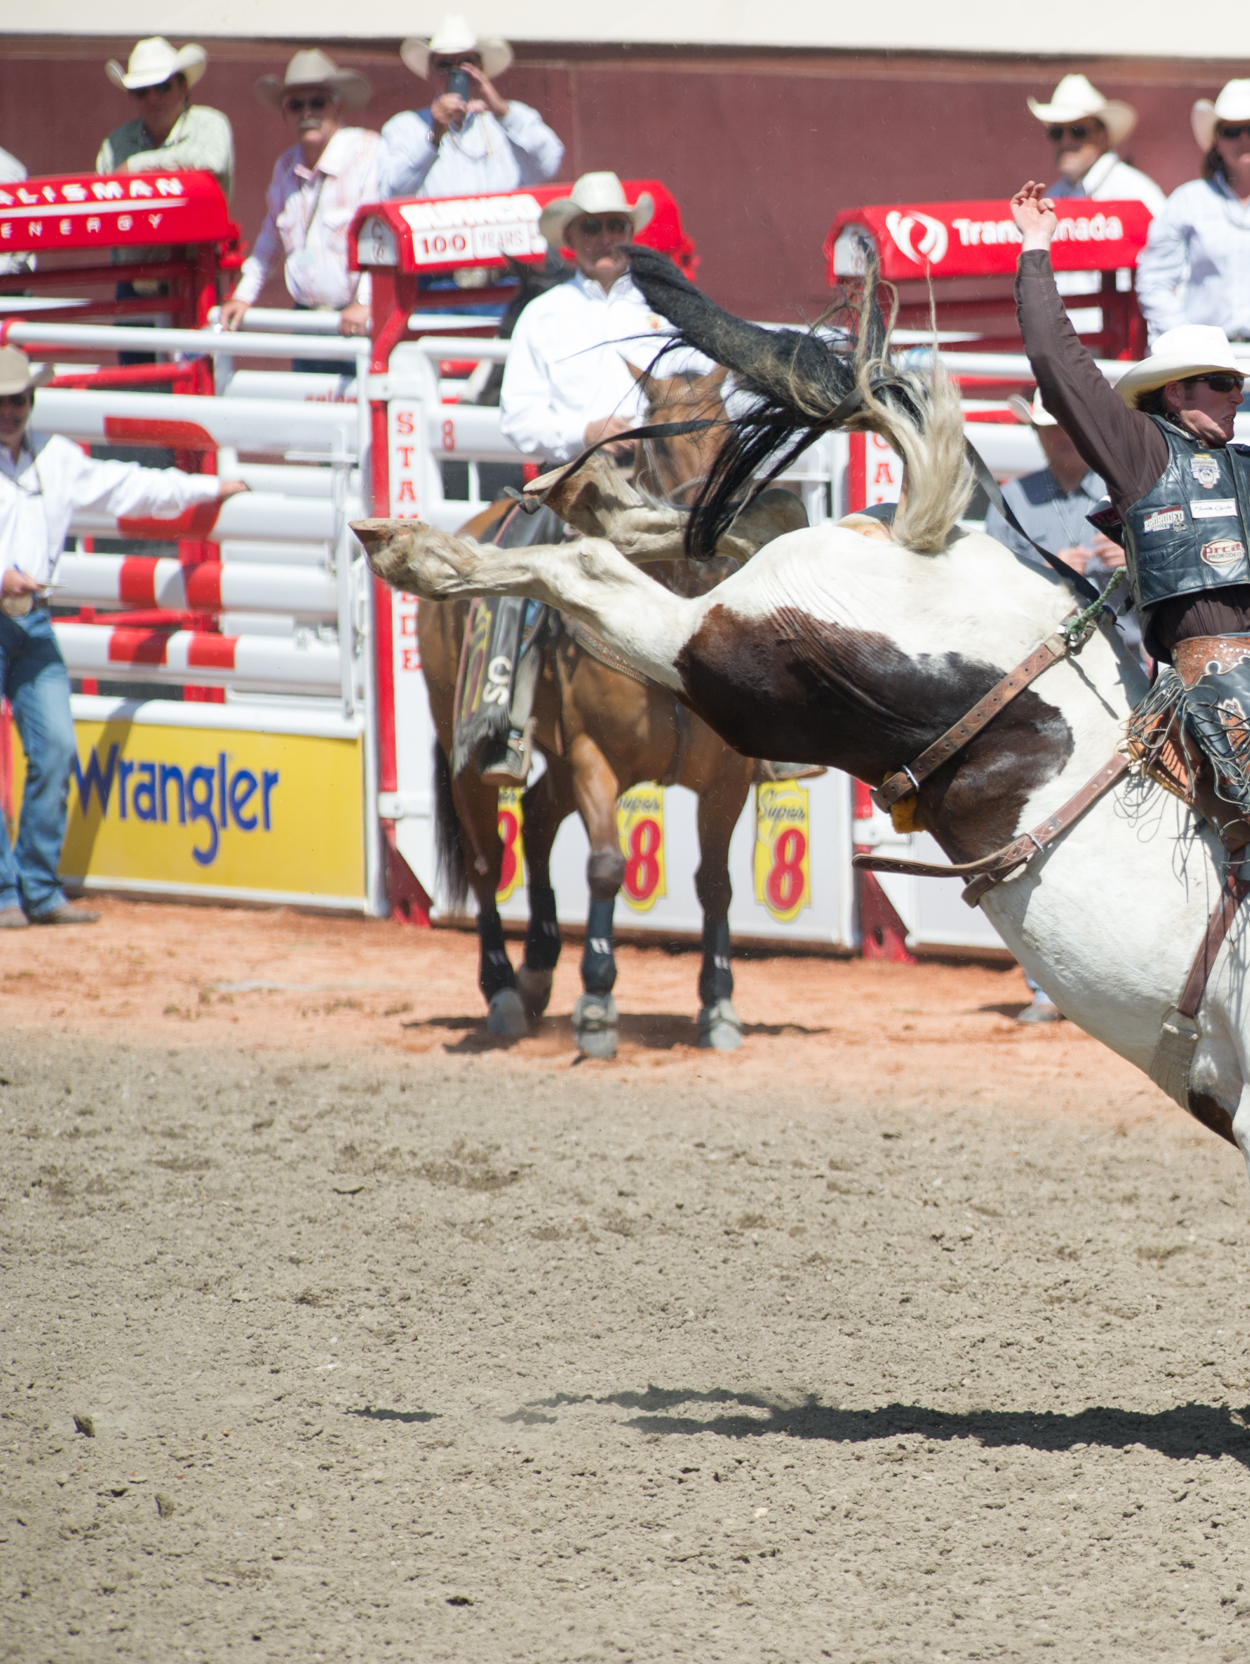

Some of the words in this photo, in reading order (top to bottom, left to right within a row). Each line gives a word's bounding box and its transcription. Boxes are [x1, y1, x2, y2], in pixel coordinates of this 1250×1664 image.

[1, 213, 163, 239] ENERGY
[422, 234, 466, 255] 100
[952, 212, 1124, 246] Trannada
[442, 419, 456, 451] 8
[396, 411, 422, 671] STADE
[1204, 543, 1241, 560] prca
[73, 741, 280, 868] Wrangler
[758, 787, 806, 830] Super
[623, 818, 661, 900] 8
[766, 828, 806, 912] 8
